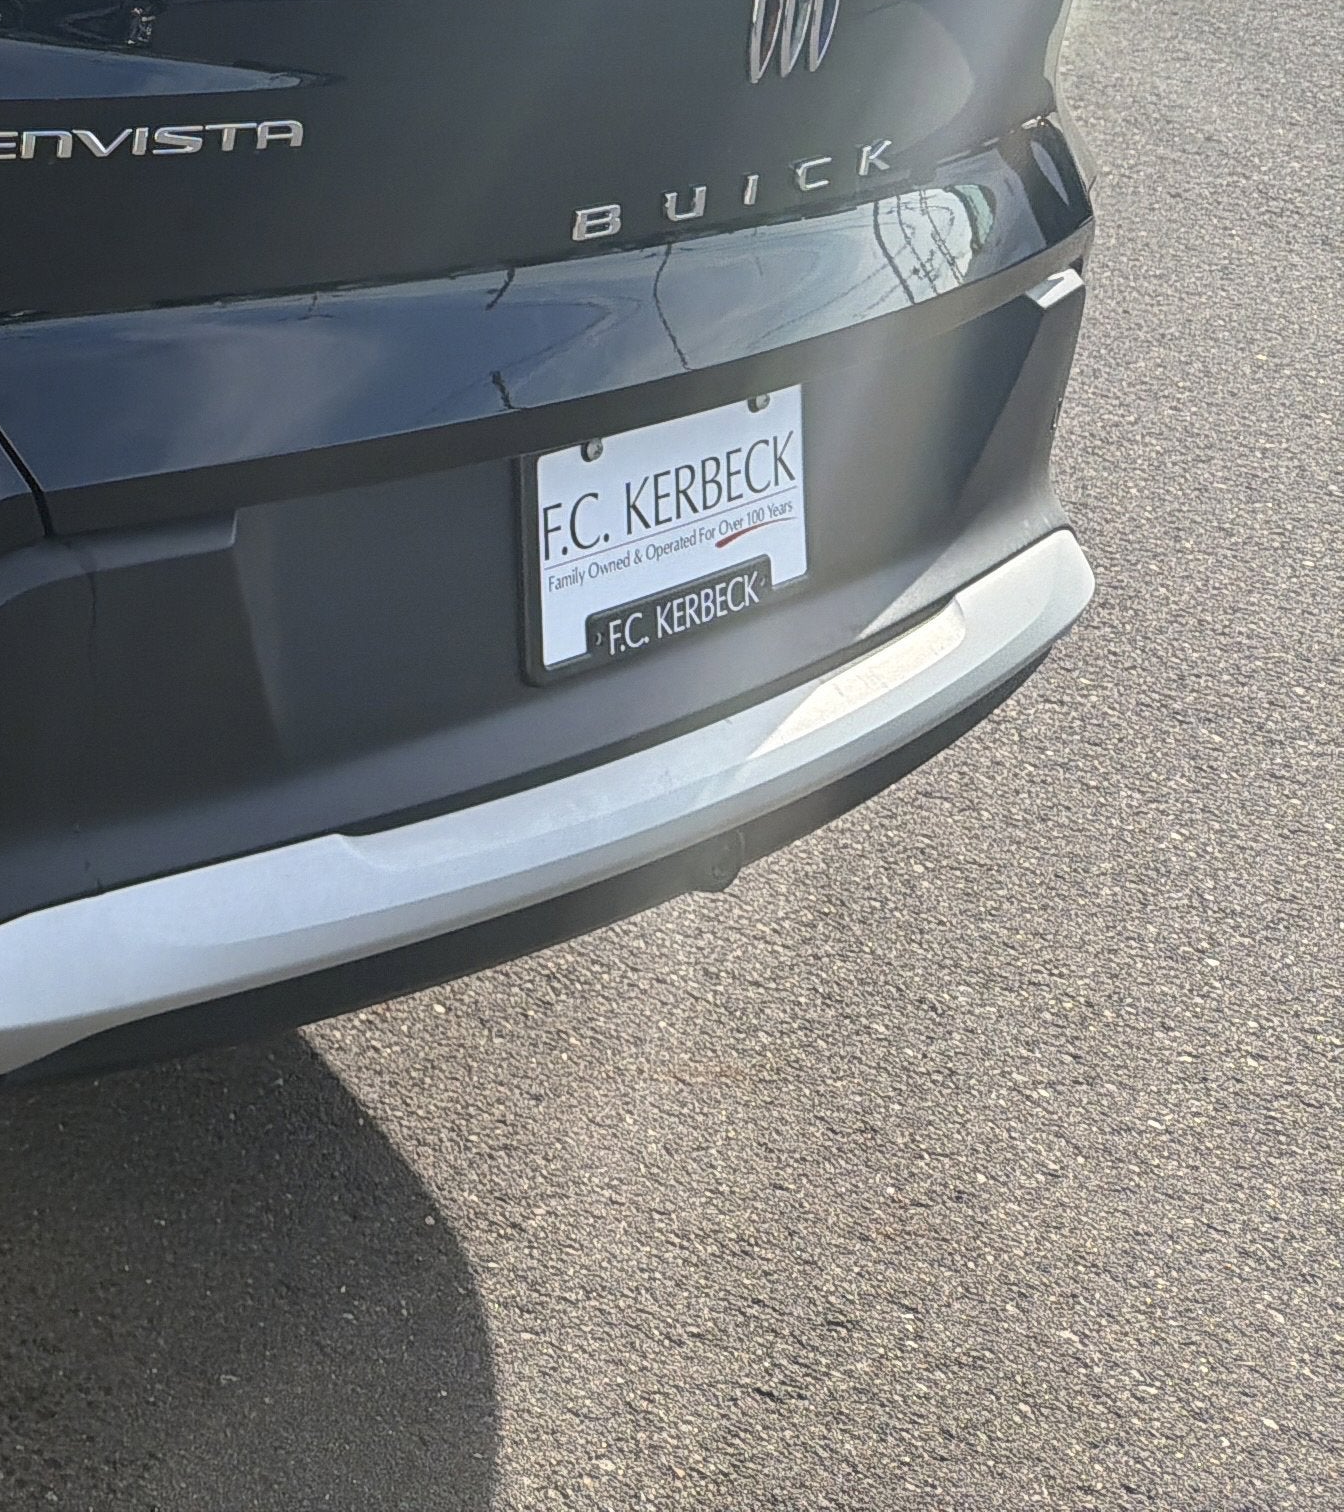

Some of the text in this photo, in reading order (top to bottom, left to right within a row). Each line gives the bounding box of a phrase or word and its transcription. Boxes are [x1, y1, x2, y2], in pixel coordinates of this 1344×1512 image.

[572, 139, 893, 241] BUICK
[543, 430, 796, 561] F.C. KERBECK
[548, 500, 794, 593] Family Owned & Operated For Over 100 Years
[609, 571, 760, 656] F.C. KERBECK
